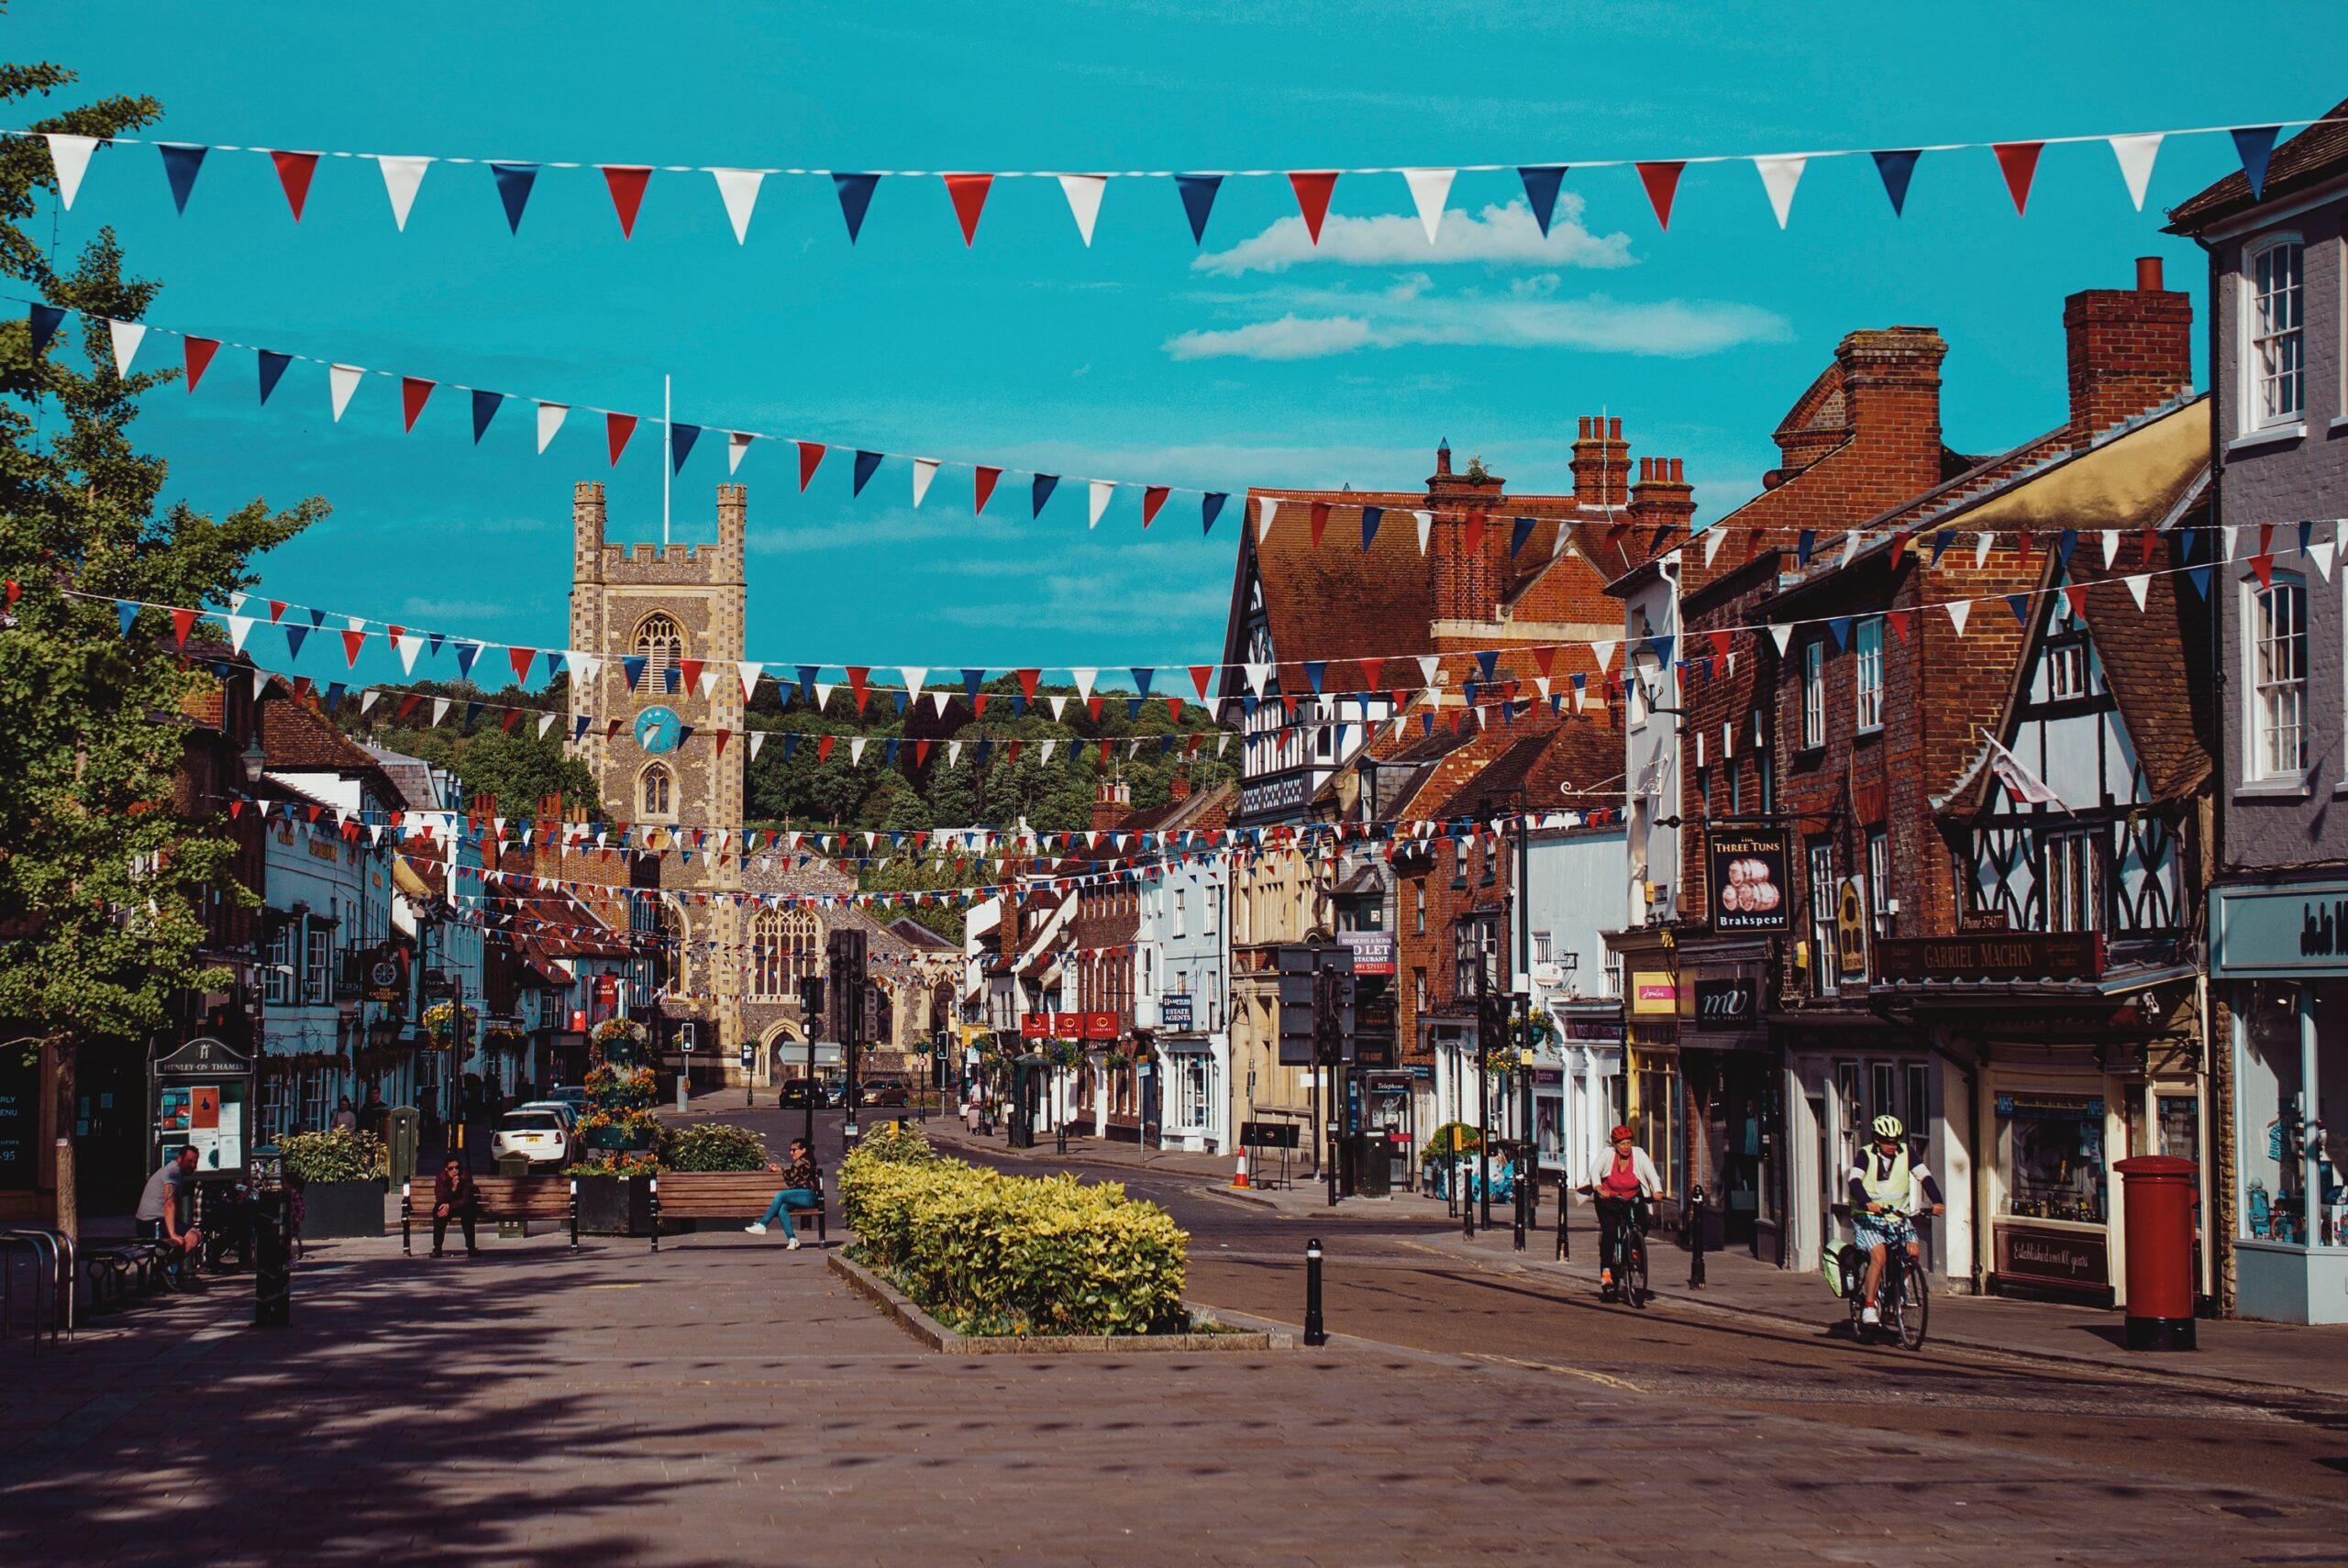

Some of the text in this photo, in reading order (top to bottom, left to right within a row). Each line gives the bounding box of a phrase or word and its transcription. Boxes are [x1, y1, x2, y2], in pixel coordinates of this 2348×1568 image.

[1714, 842, 1780, 853] THREE TUNS
[1720, 915, 1785, 927] Brakspear
[1354, 944, 1390, 955] O LET
[1923, 945, 1974, 968] GABRIEL
[1981, 944, 2032, 966] MACHIN
[1998, 1094, 2014, 1111] NHS
